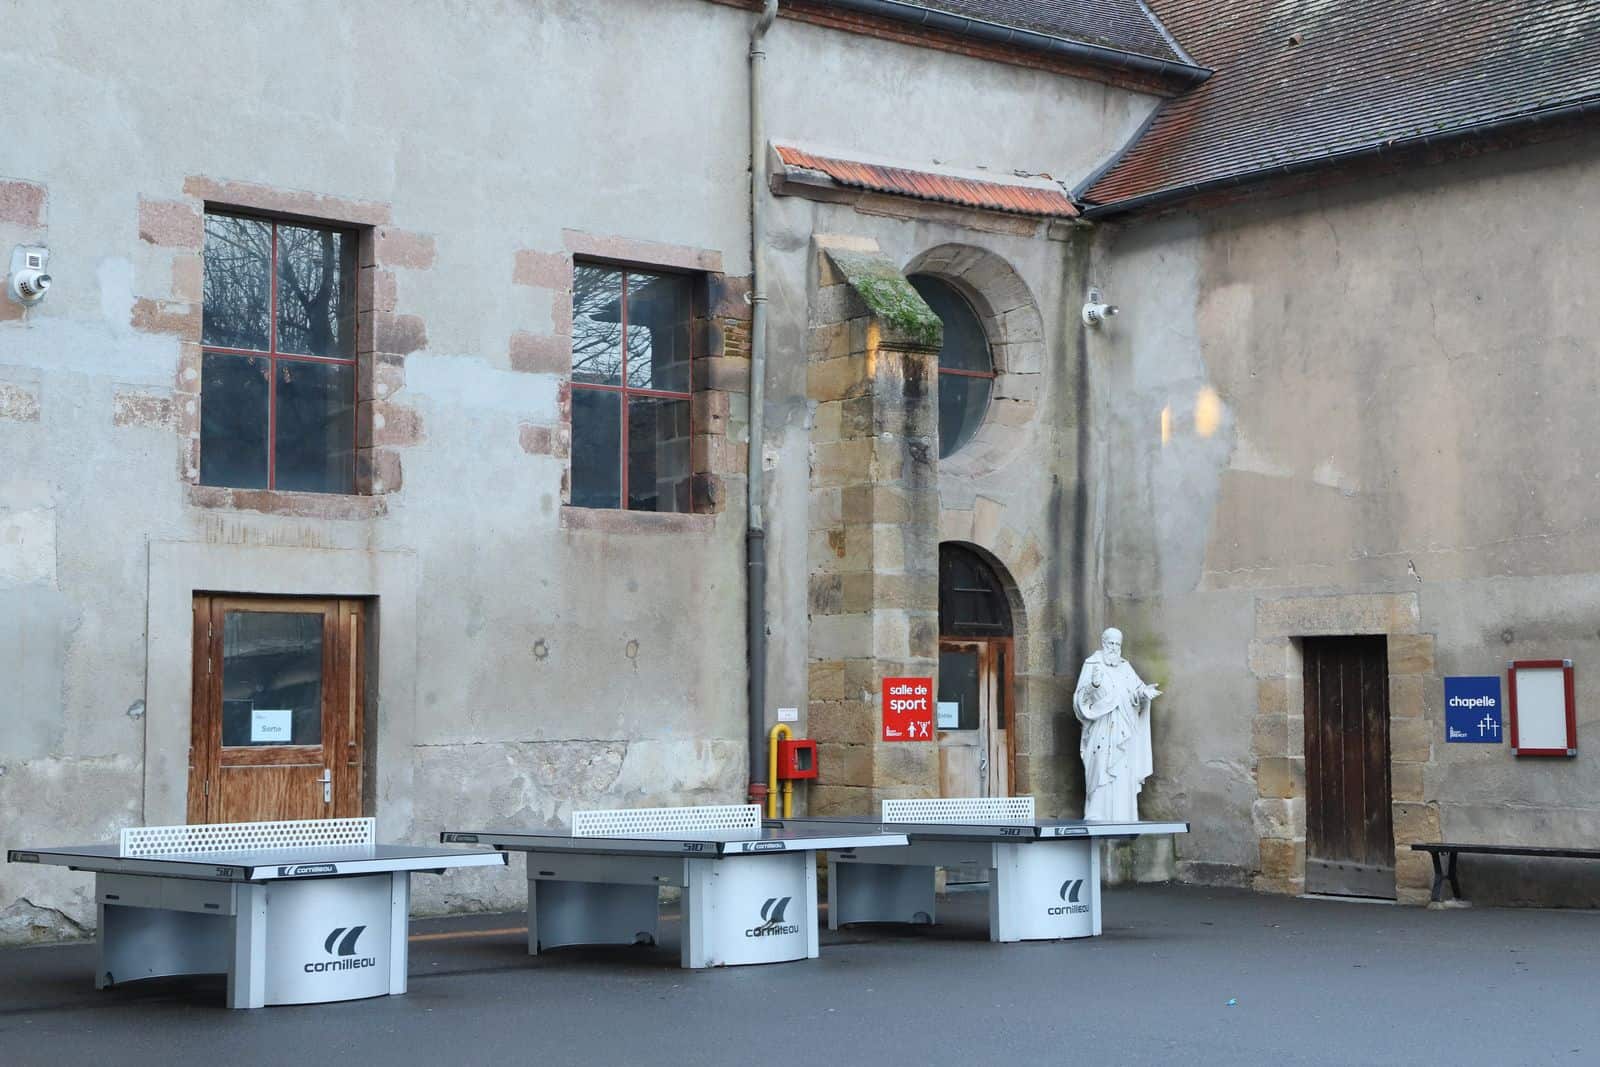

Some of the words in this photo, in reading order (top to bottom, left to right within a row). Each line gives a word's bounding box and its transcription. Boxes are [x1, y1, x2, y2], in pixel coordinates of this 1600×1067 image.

[889, 684, 913, 695] salle
[914, 684, 928, 695] de
[890, 697, 927, 714] sport
[1449, 695, 1496, 709] chapelle
[1047, 904, 1089, 915] cornilleau
[745, 925, 799, 937] cornilleau
[304, 957, 376, 973] cornilleau
